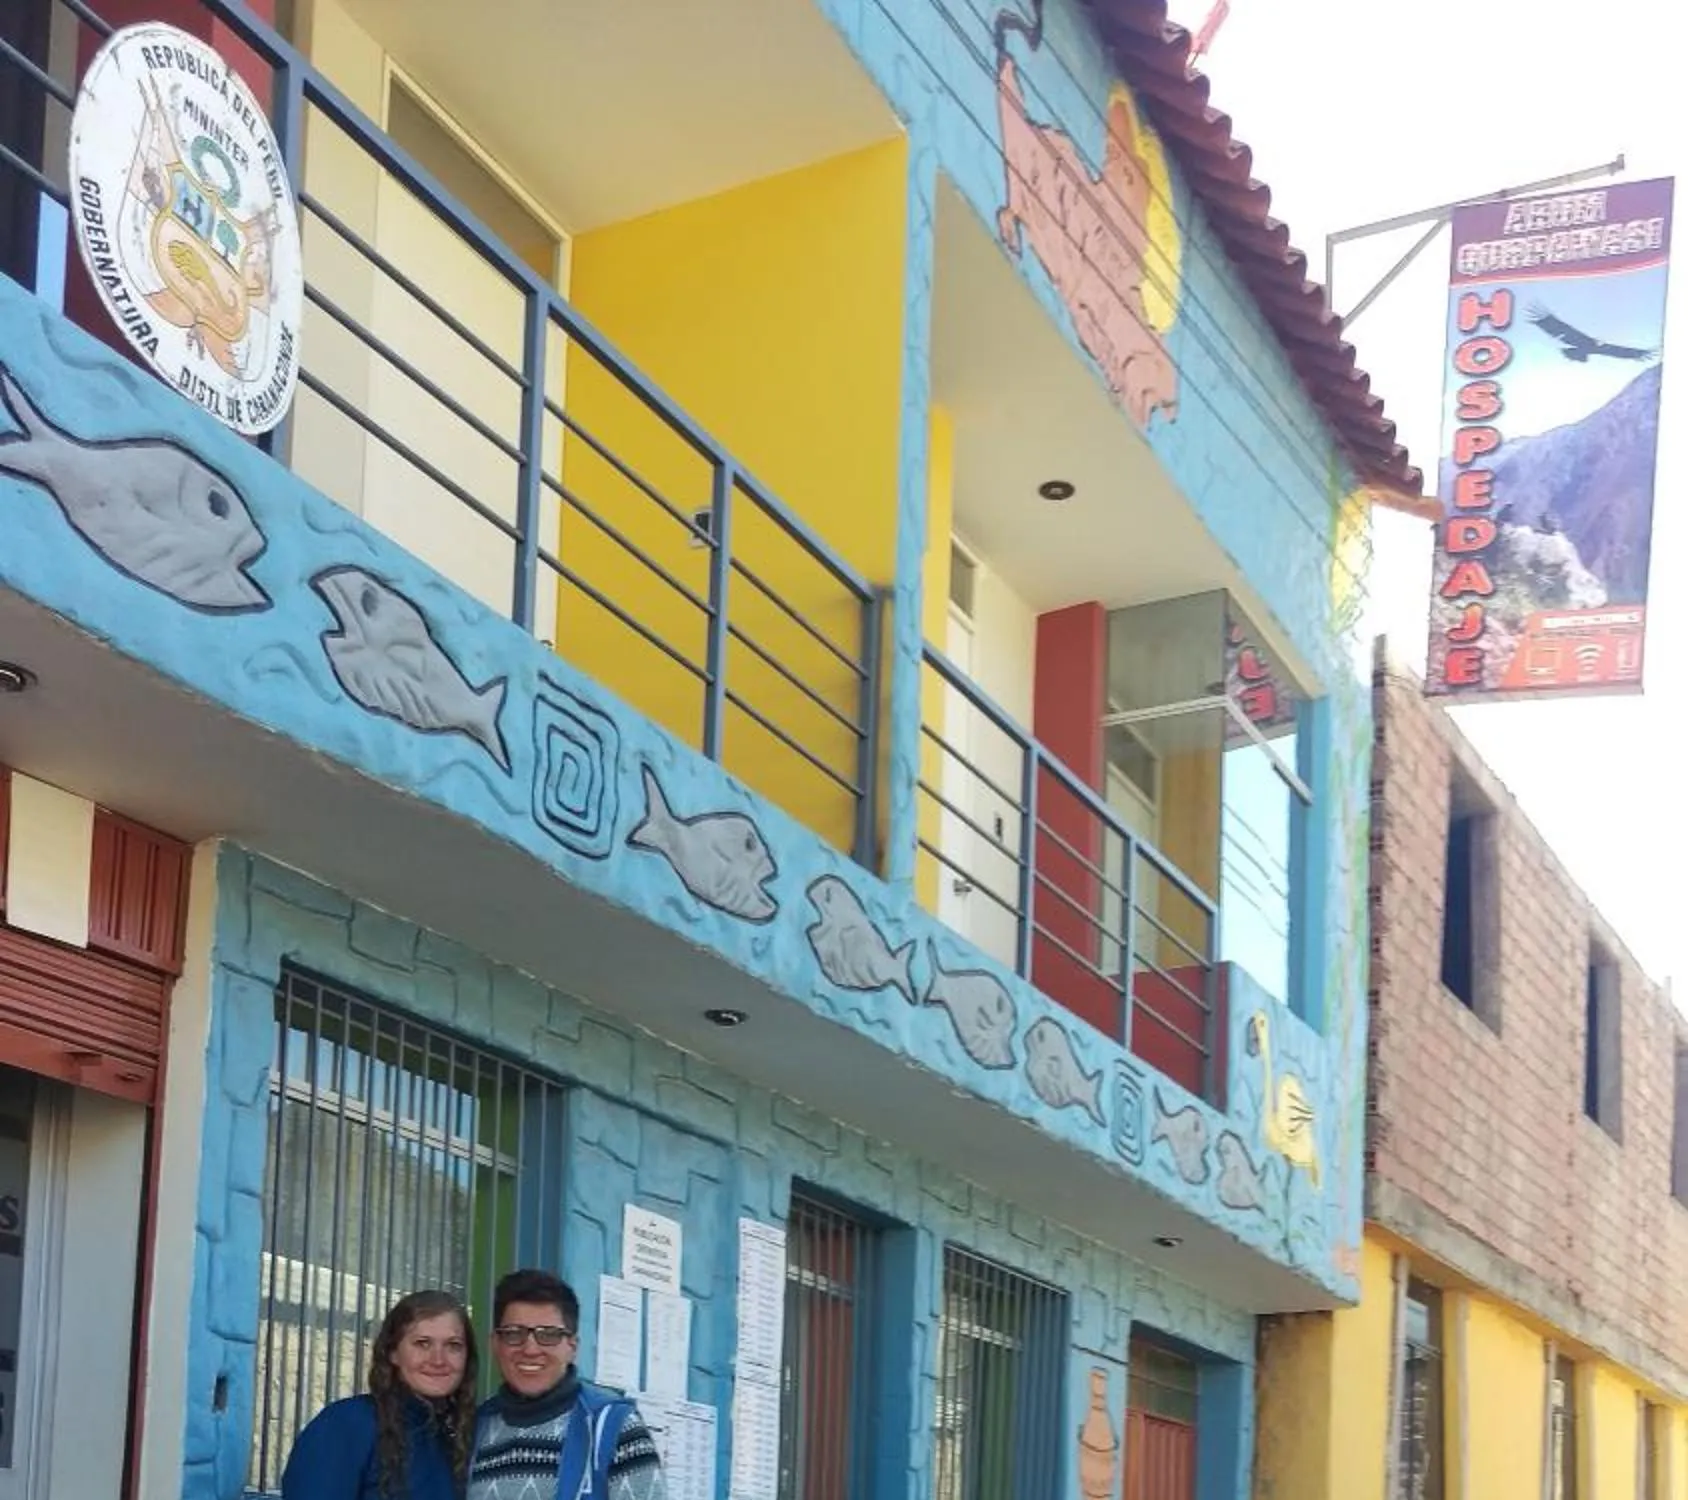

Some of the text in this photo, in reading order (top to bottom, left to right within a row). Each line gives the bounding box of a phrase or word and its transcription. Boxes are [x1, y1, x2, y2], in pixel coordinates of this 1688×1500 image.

[140, 45, 284, 200] REPUBLICA DEL PERU
[183, 96, 250, 173] MININTER
[79, 176, 160, 359] GOBERNATURA
[226, 396, 242, 422] DE
[1440, 288, 1514, 686] HOSPEDAJE
